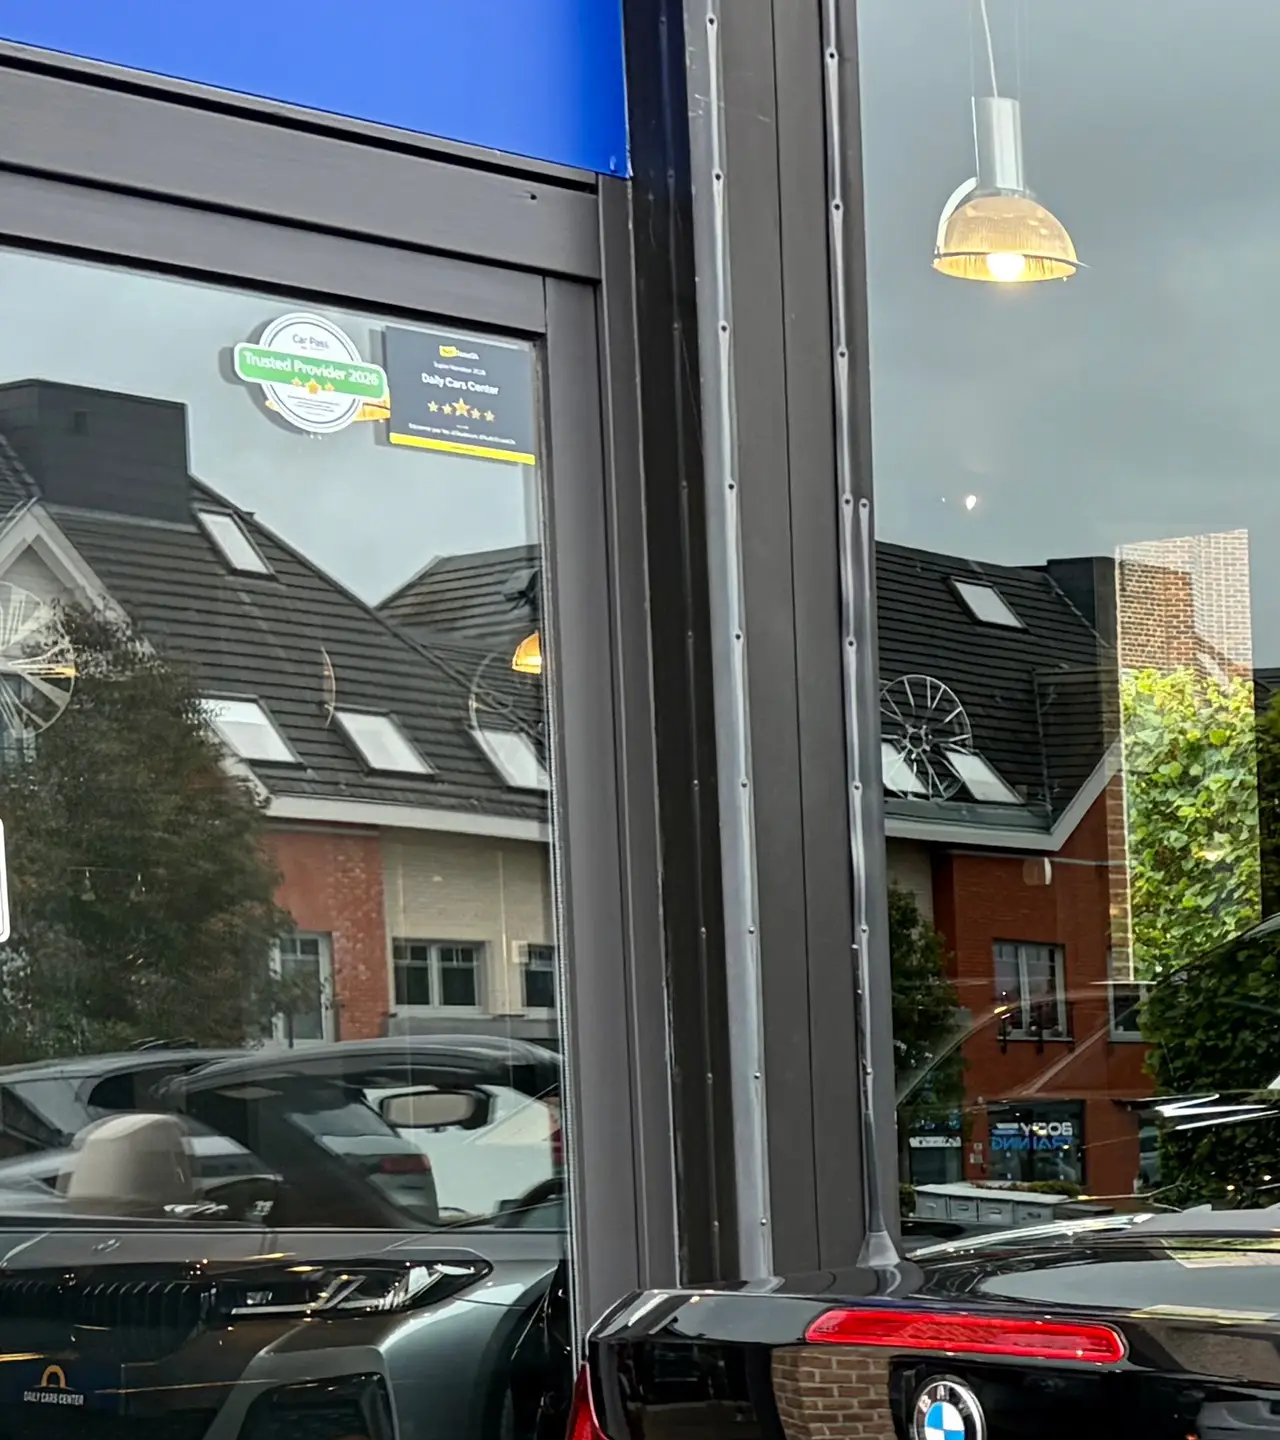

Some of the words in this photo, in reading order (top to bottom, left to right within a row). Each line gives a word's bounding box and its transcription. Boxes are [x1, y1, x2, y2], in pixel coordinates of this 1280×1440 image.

[242, 350, 292, 372] Trusted
[293, 358, 347, 381] Provider
[421, 372, 444, 388] Daily
[445, 377, 467, 390] Cars
[467, 381, 499, 395] Center
[23, 1390, 40, 1402] DAILY
[40, 1392, 58, 1404] CARS
[58, 1393, 84, 1406] CENTER
